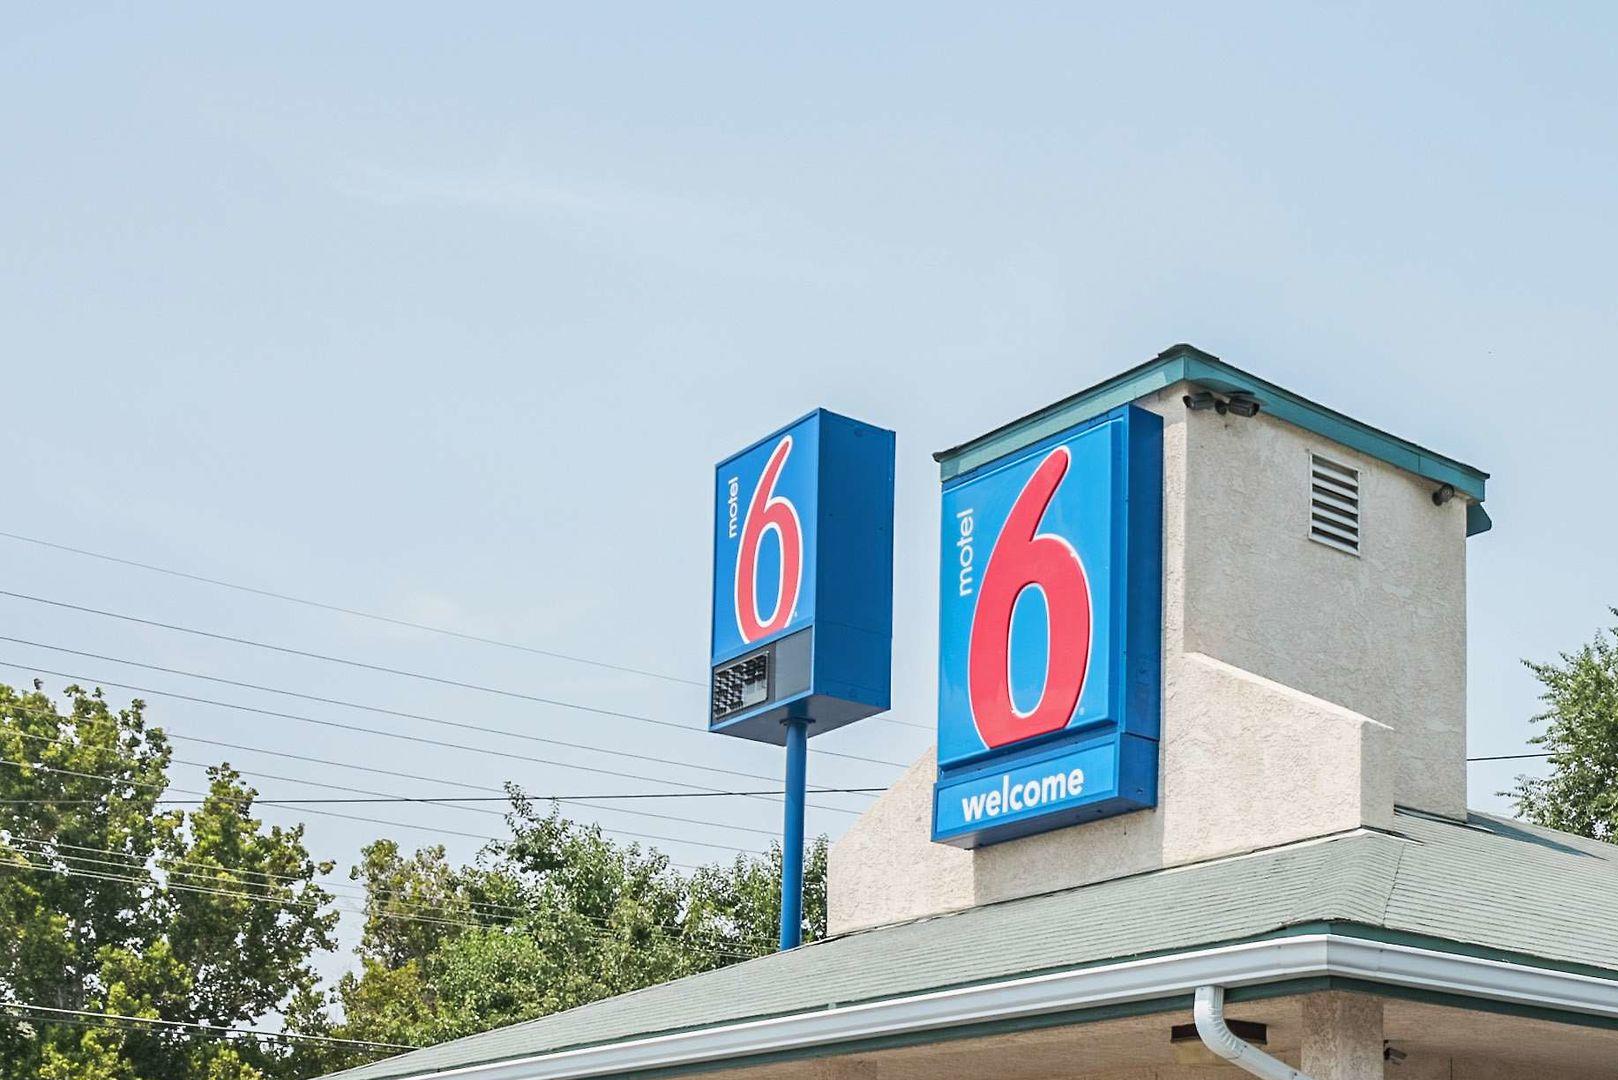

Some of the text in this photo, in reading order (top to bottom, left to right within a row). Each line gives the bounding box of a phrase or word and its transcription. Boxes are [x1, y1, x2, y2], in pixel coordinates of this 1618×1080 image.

[728, 435, 802, 645] motel 6
[956, 446, 1093, 750] motel 6
[962, 768, 1084, 822] welcome
